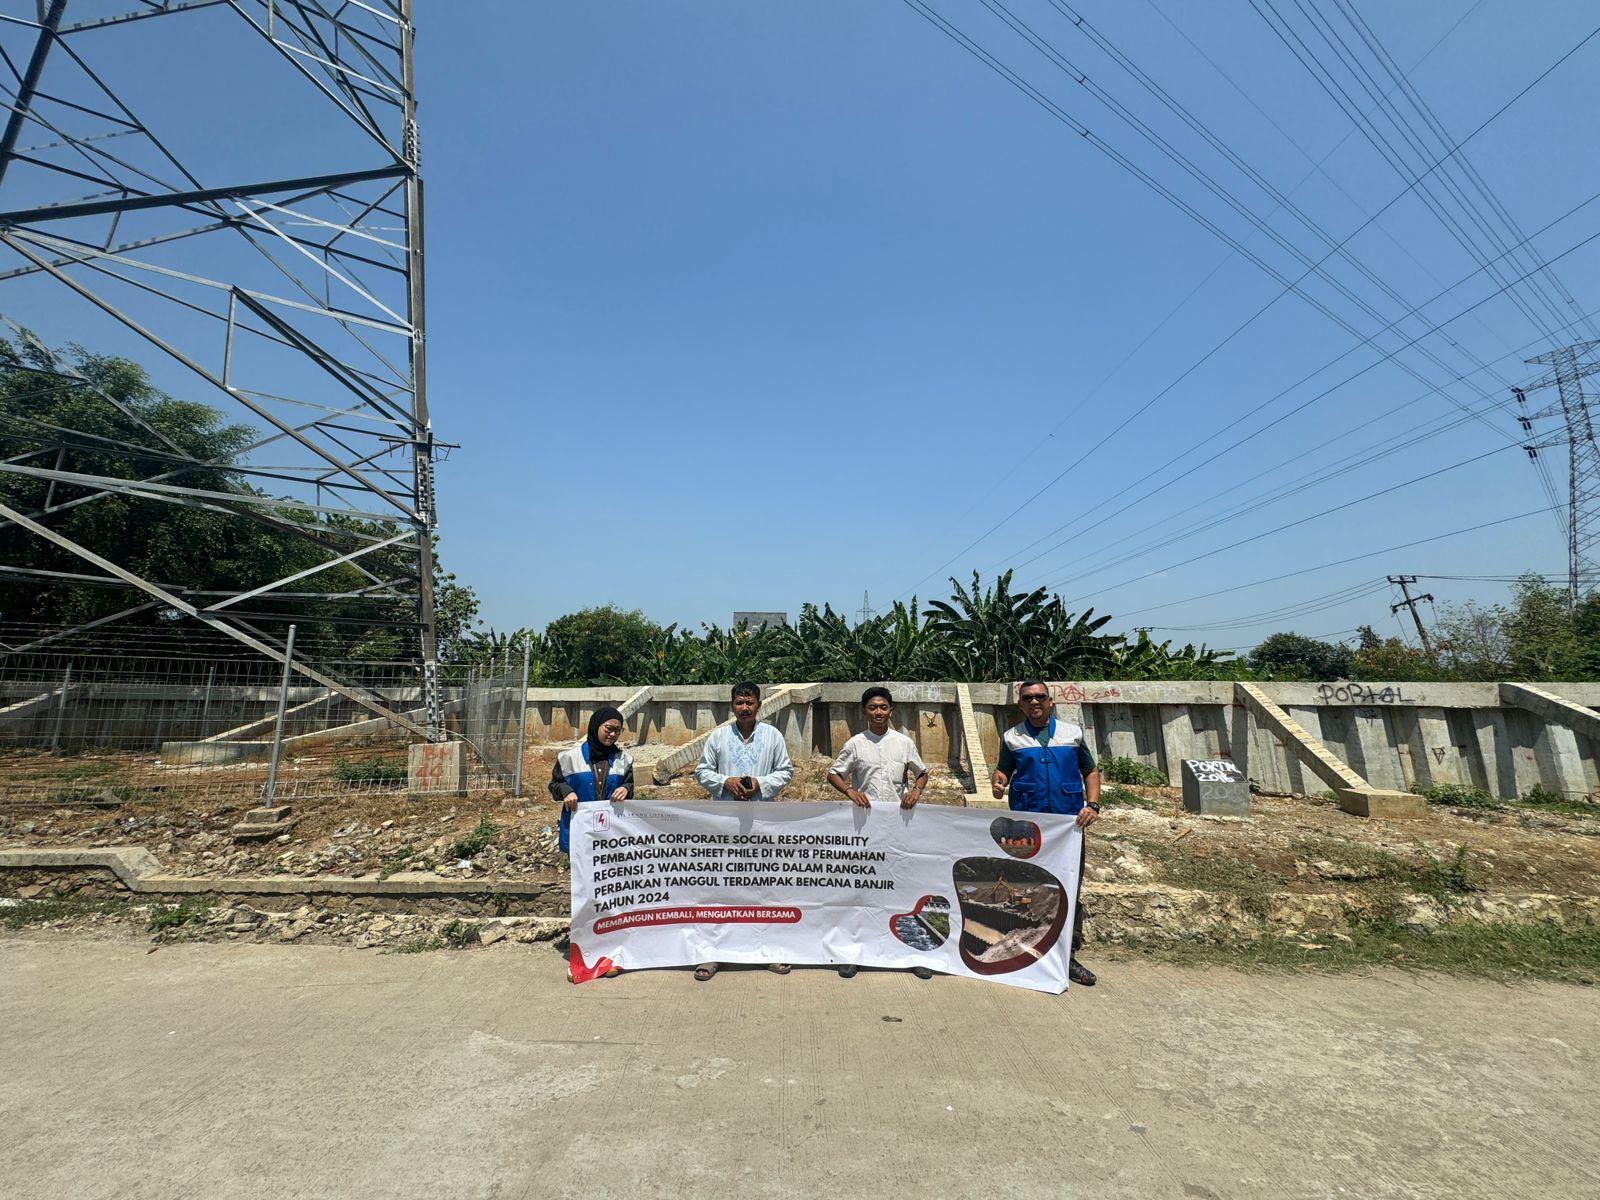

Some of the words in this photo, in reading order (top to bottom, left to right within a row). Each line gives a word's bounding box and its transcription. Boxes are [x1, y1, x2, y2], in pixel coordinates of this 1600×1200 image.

[1318, 683, 1416, 705] PORTAL
[592, 834, 655, 850] PROGRAM
[658, 833, 729, 844] CORPORATE
[732, 835, 775, 845] SOCIAL
[778, 835, 869, 847] RESPONSIBILITY
[592, 849, 687, 867] PEMBANGUNAN
[690, 848, 725, 858] SHEET
[727, 848, 758, 858] PHILE
[761, 849, 772, 858] DI
[775, 849, 795, 858] RW
[798, 849, 809, 858] 18
[812, 850, 886, 861] PERUMAHAN
[593, 865, 643, 882] REGENSI
[646, 863, 655, 873] 2
[658, 862, 723, 873] WANASARI
[726, 862, 779, 872] CIBITUNG
[782, 863, 823, 873] DALAM
[826, 864, 877, 875] RANGKA
[594, 877, 661, 899] PERBAIKAN
[664, 876, 720, 887] TANGGUL
[723, 876, 794, 887] TERDAMPAK
[796, 877, 851, 888] BENCANA
[854, 879, 895, 890] BANJIR
[594, 895, 635, 913] TAHUN
[638, 891, 670, 904] 2024
[597, 913, 654, 930] MEMBANGUN
[655, 911, 695, 920] KEMBALI,
[696, 910, 755, 919] MENGUATKAN
[756, 911, 796, 919] BERSAMA
